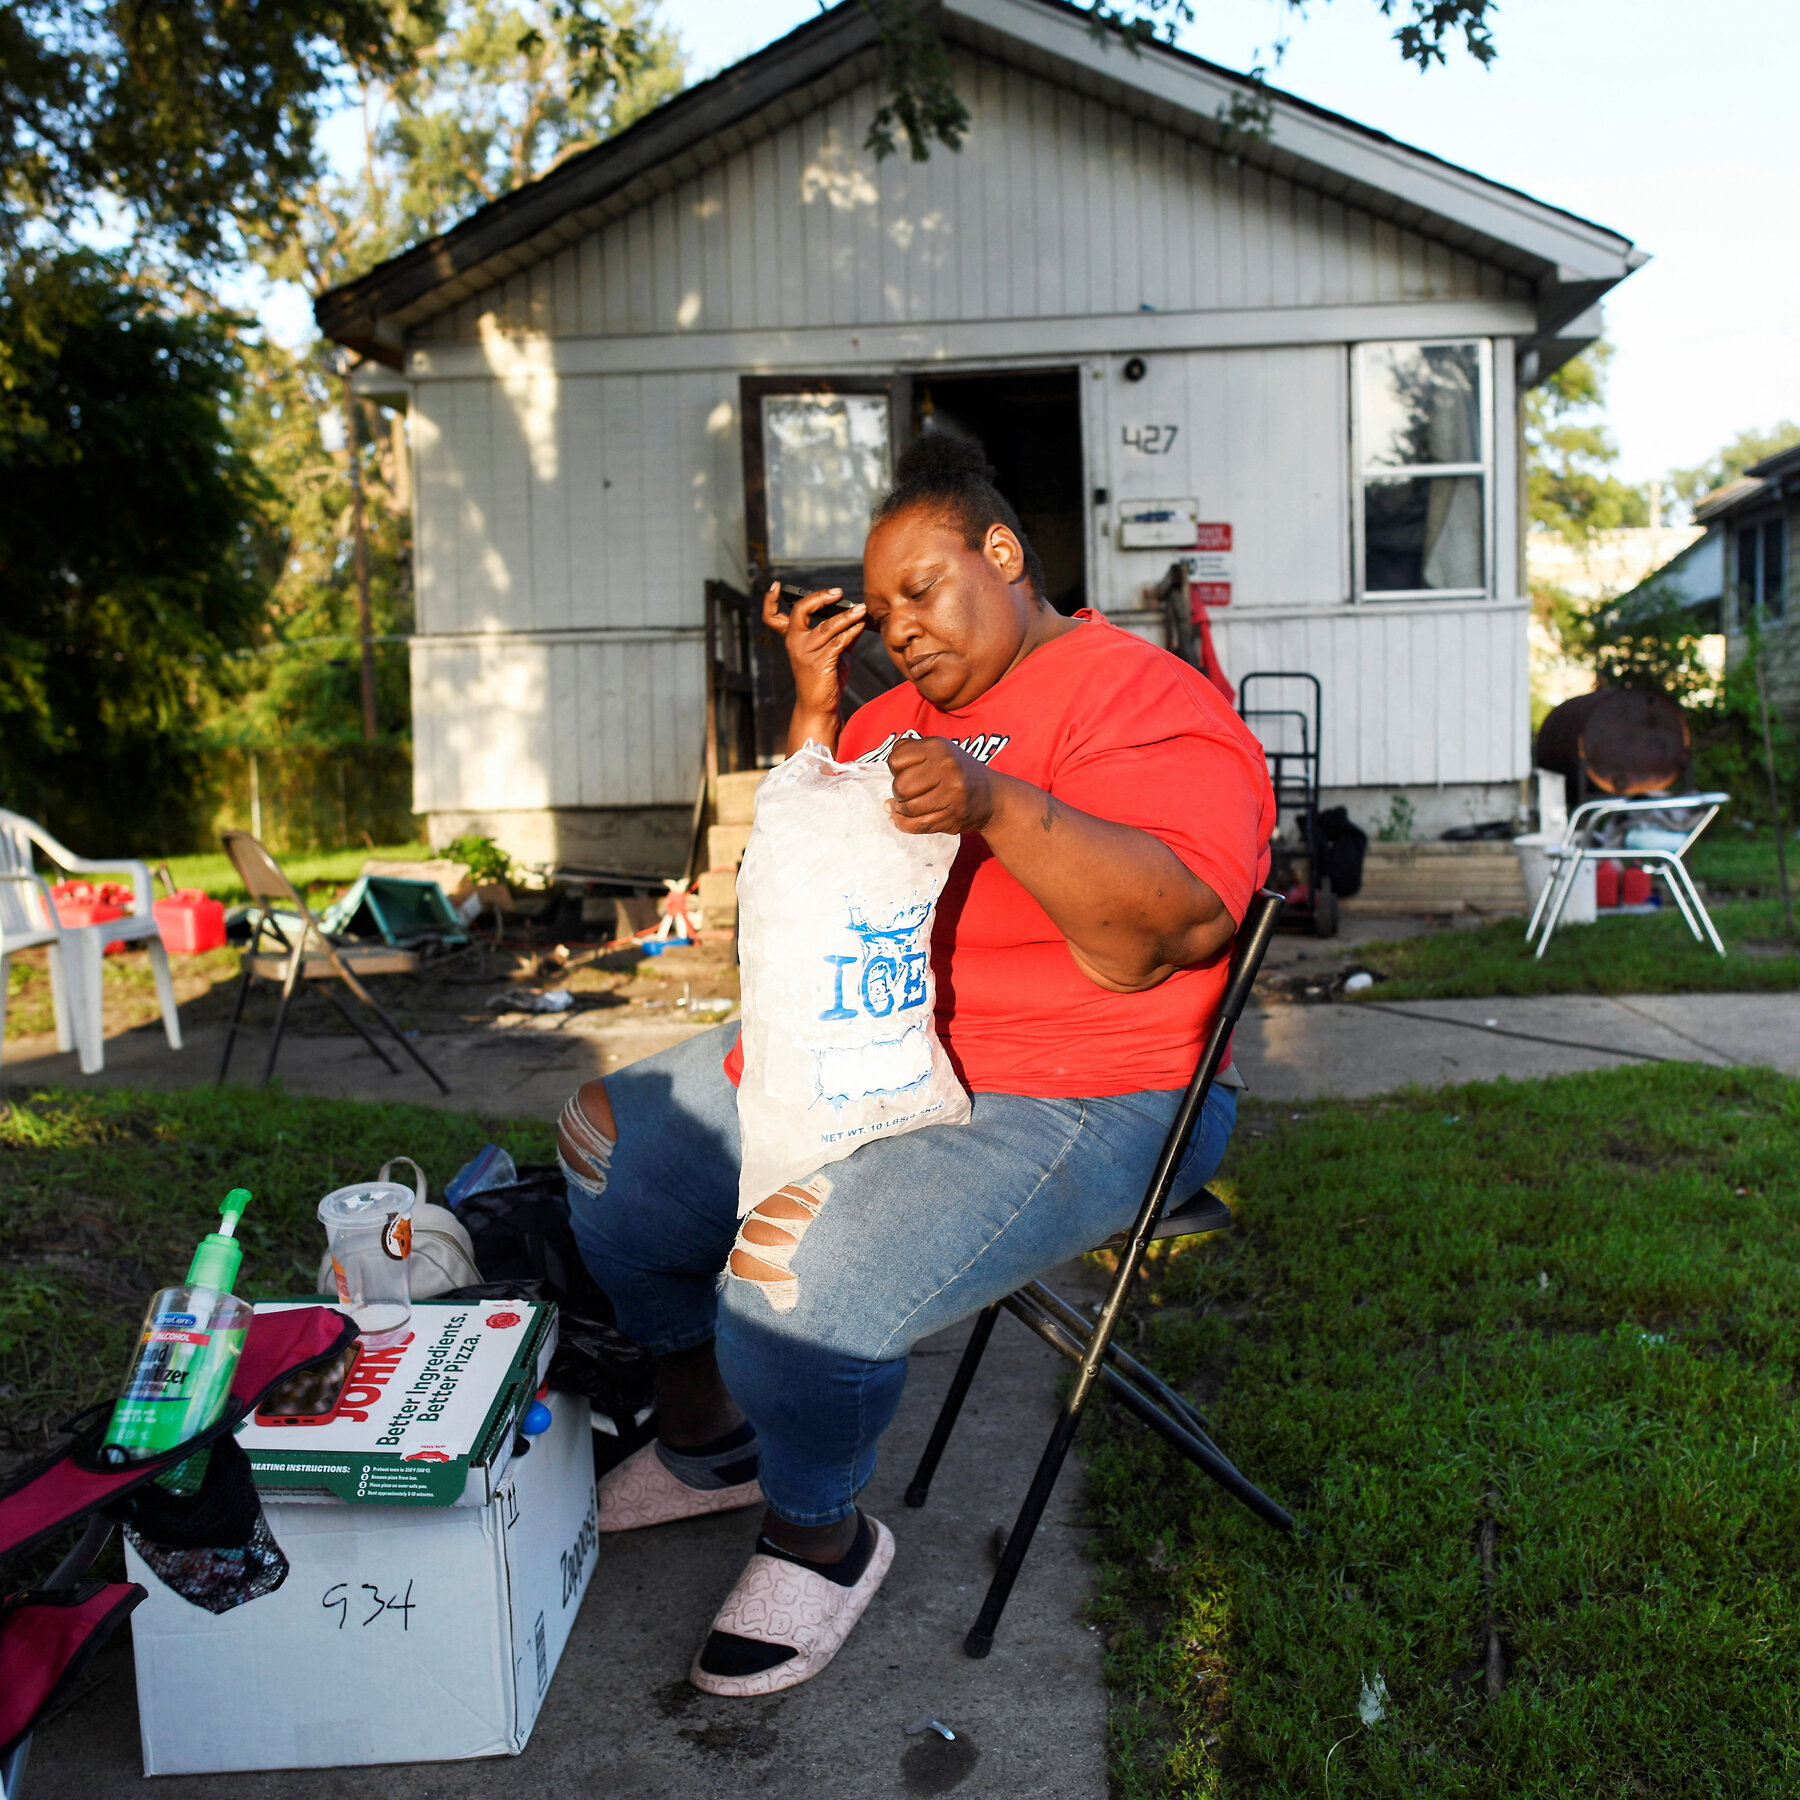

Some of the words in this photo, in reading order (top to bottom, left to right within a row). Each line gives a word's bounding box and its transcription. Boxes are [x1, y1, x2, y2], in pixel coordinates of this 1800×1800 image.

[1121, 424, 1179, 454] 427
[818, 951, 928, 1021] ICE
[820, 1132, 844, 1143] NET
[847, 1127, 866, 1137] WT.
[871, 1122, 882, 1132] 10
[376, 1398, 420, 1445] Better
[405, 1313, 468, 1394] Ingredients.
[416, 1376, 459, 1421] Better
[443, 1334, 482, 1372] Pizza.
[286, 1463, 351, 1474] INSTRUCTIONS:
[322, 1579, 416, 1631] 934
